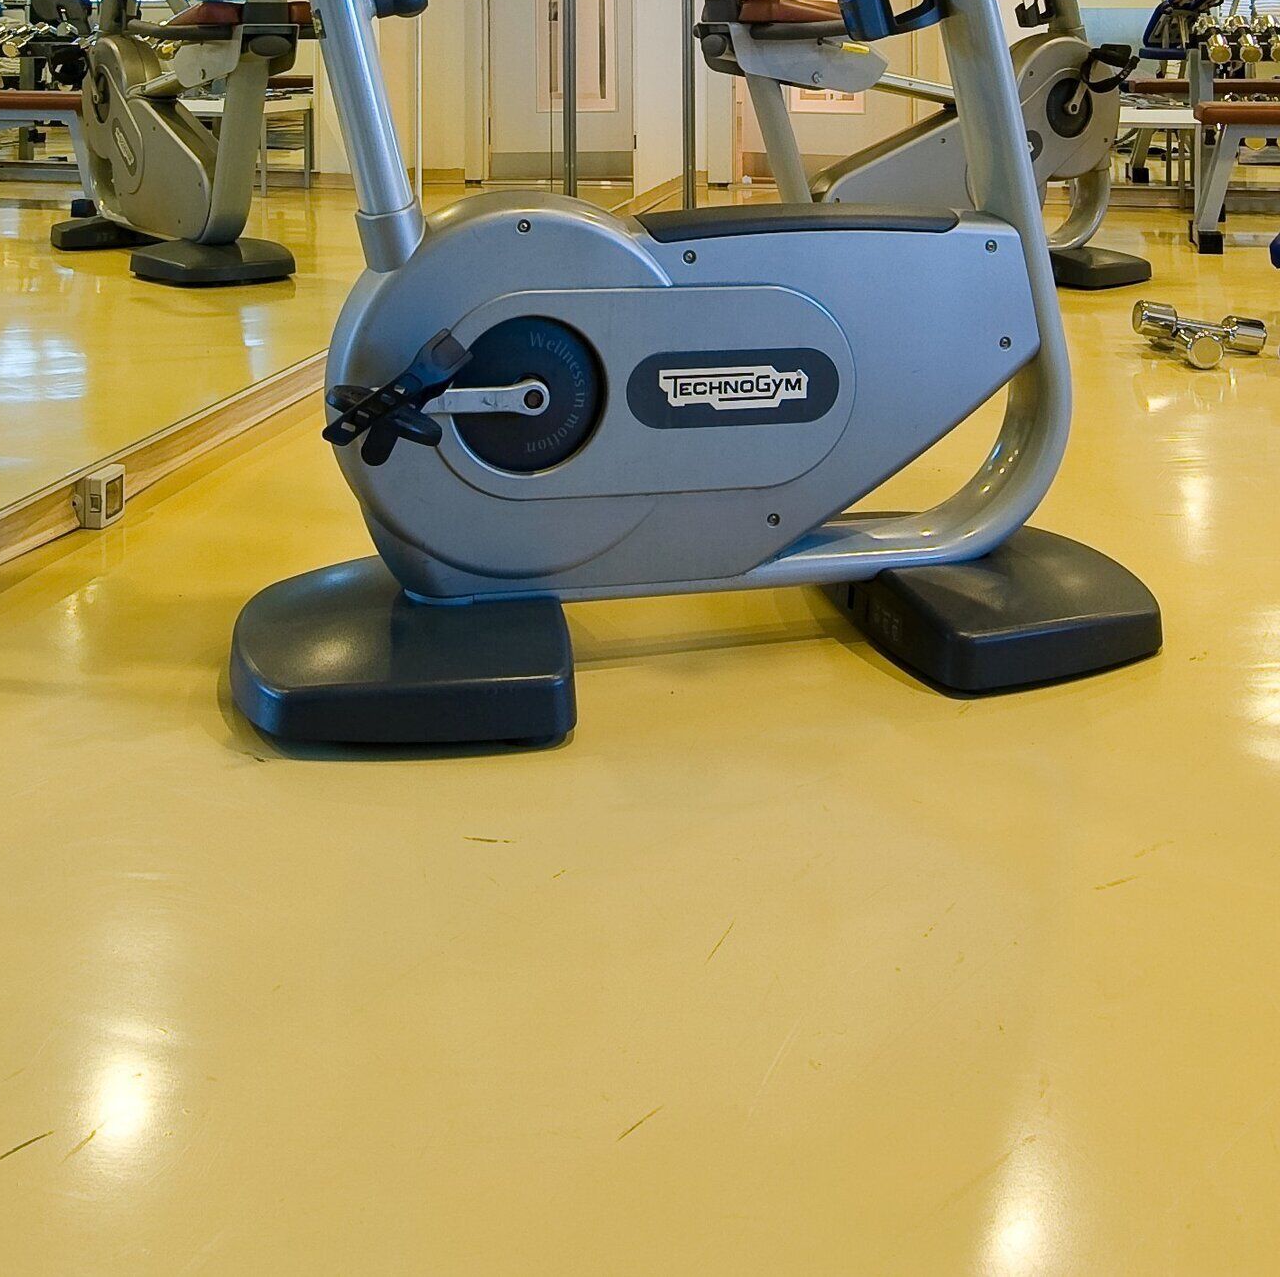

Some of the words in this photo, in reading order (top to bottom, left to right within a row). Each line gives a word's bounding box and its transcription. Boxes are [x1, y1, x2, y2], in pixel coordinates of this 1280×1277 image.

[529, 331, 586, 388] Wellness
[575, 392, 586, 408] in
[663, 372, 802, 402] TECHNOGYM
[527, 413, 580, 453] motion
